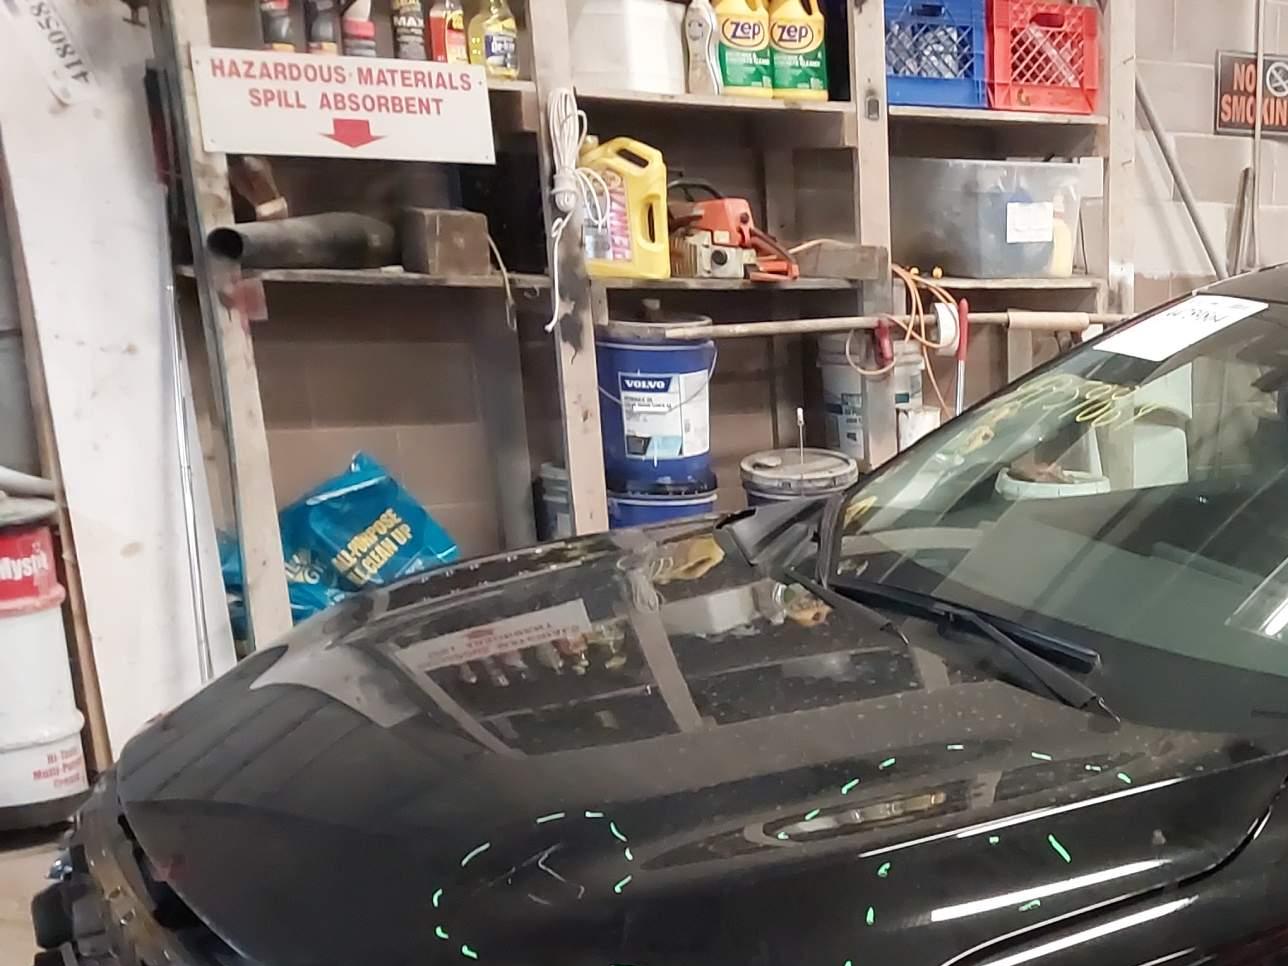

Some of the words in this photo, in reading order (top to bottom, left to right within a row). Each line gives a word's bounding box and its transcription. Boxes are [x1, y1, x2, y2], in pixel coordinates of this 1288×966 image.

[210, 58, 346, 84] HAZARDOUS
[357, 67, 472, 91] MATERIALS
[1233, 62, 1256, 93] NO
[249, 88, 307, 109] SPILL
[319, 93, 443, 115] ABSORBENT
[624, 379, 665, 389] VOLVO
